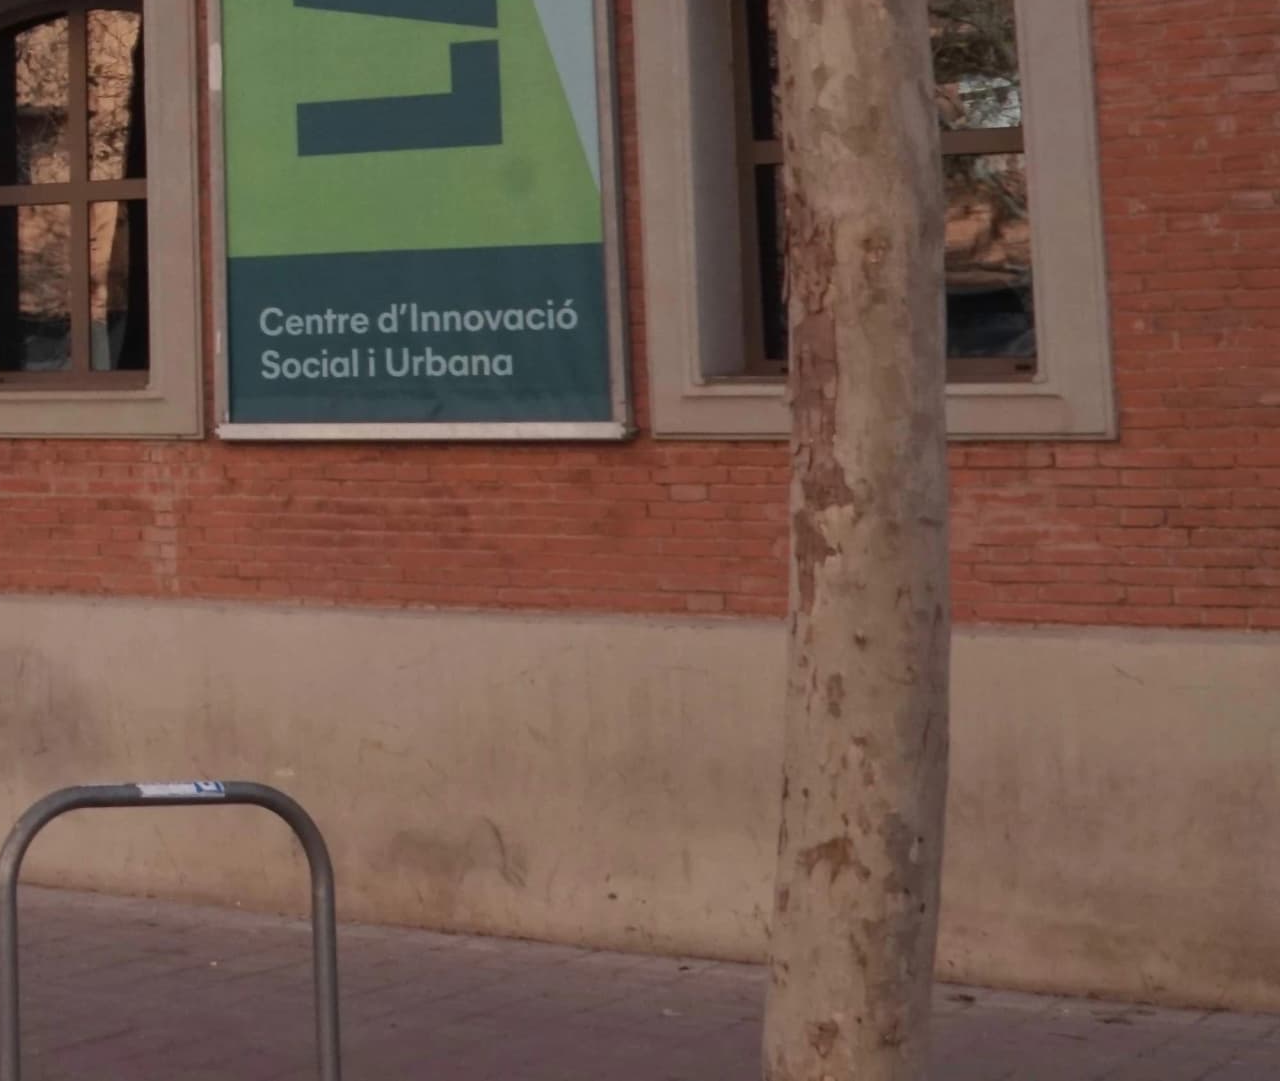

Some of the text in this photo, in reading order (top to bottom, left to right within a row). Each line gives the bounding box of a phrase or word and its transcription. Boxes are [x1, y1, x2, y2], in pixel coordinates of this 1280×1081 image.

[259, 307, 369, 336] Centre
[260, 347, 513, 379] Social i Urbana
